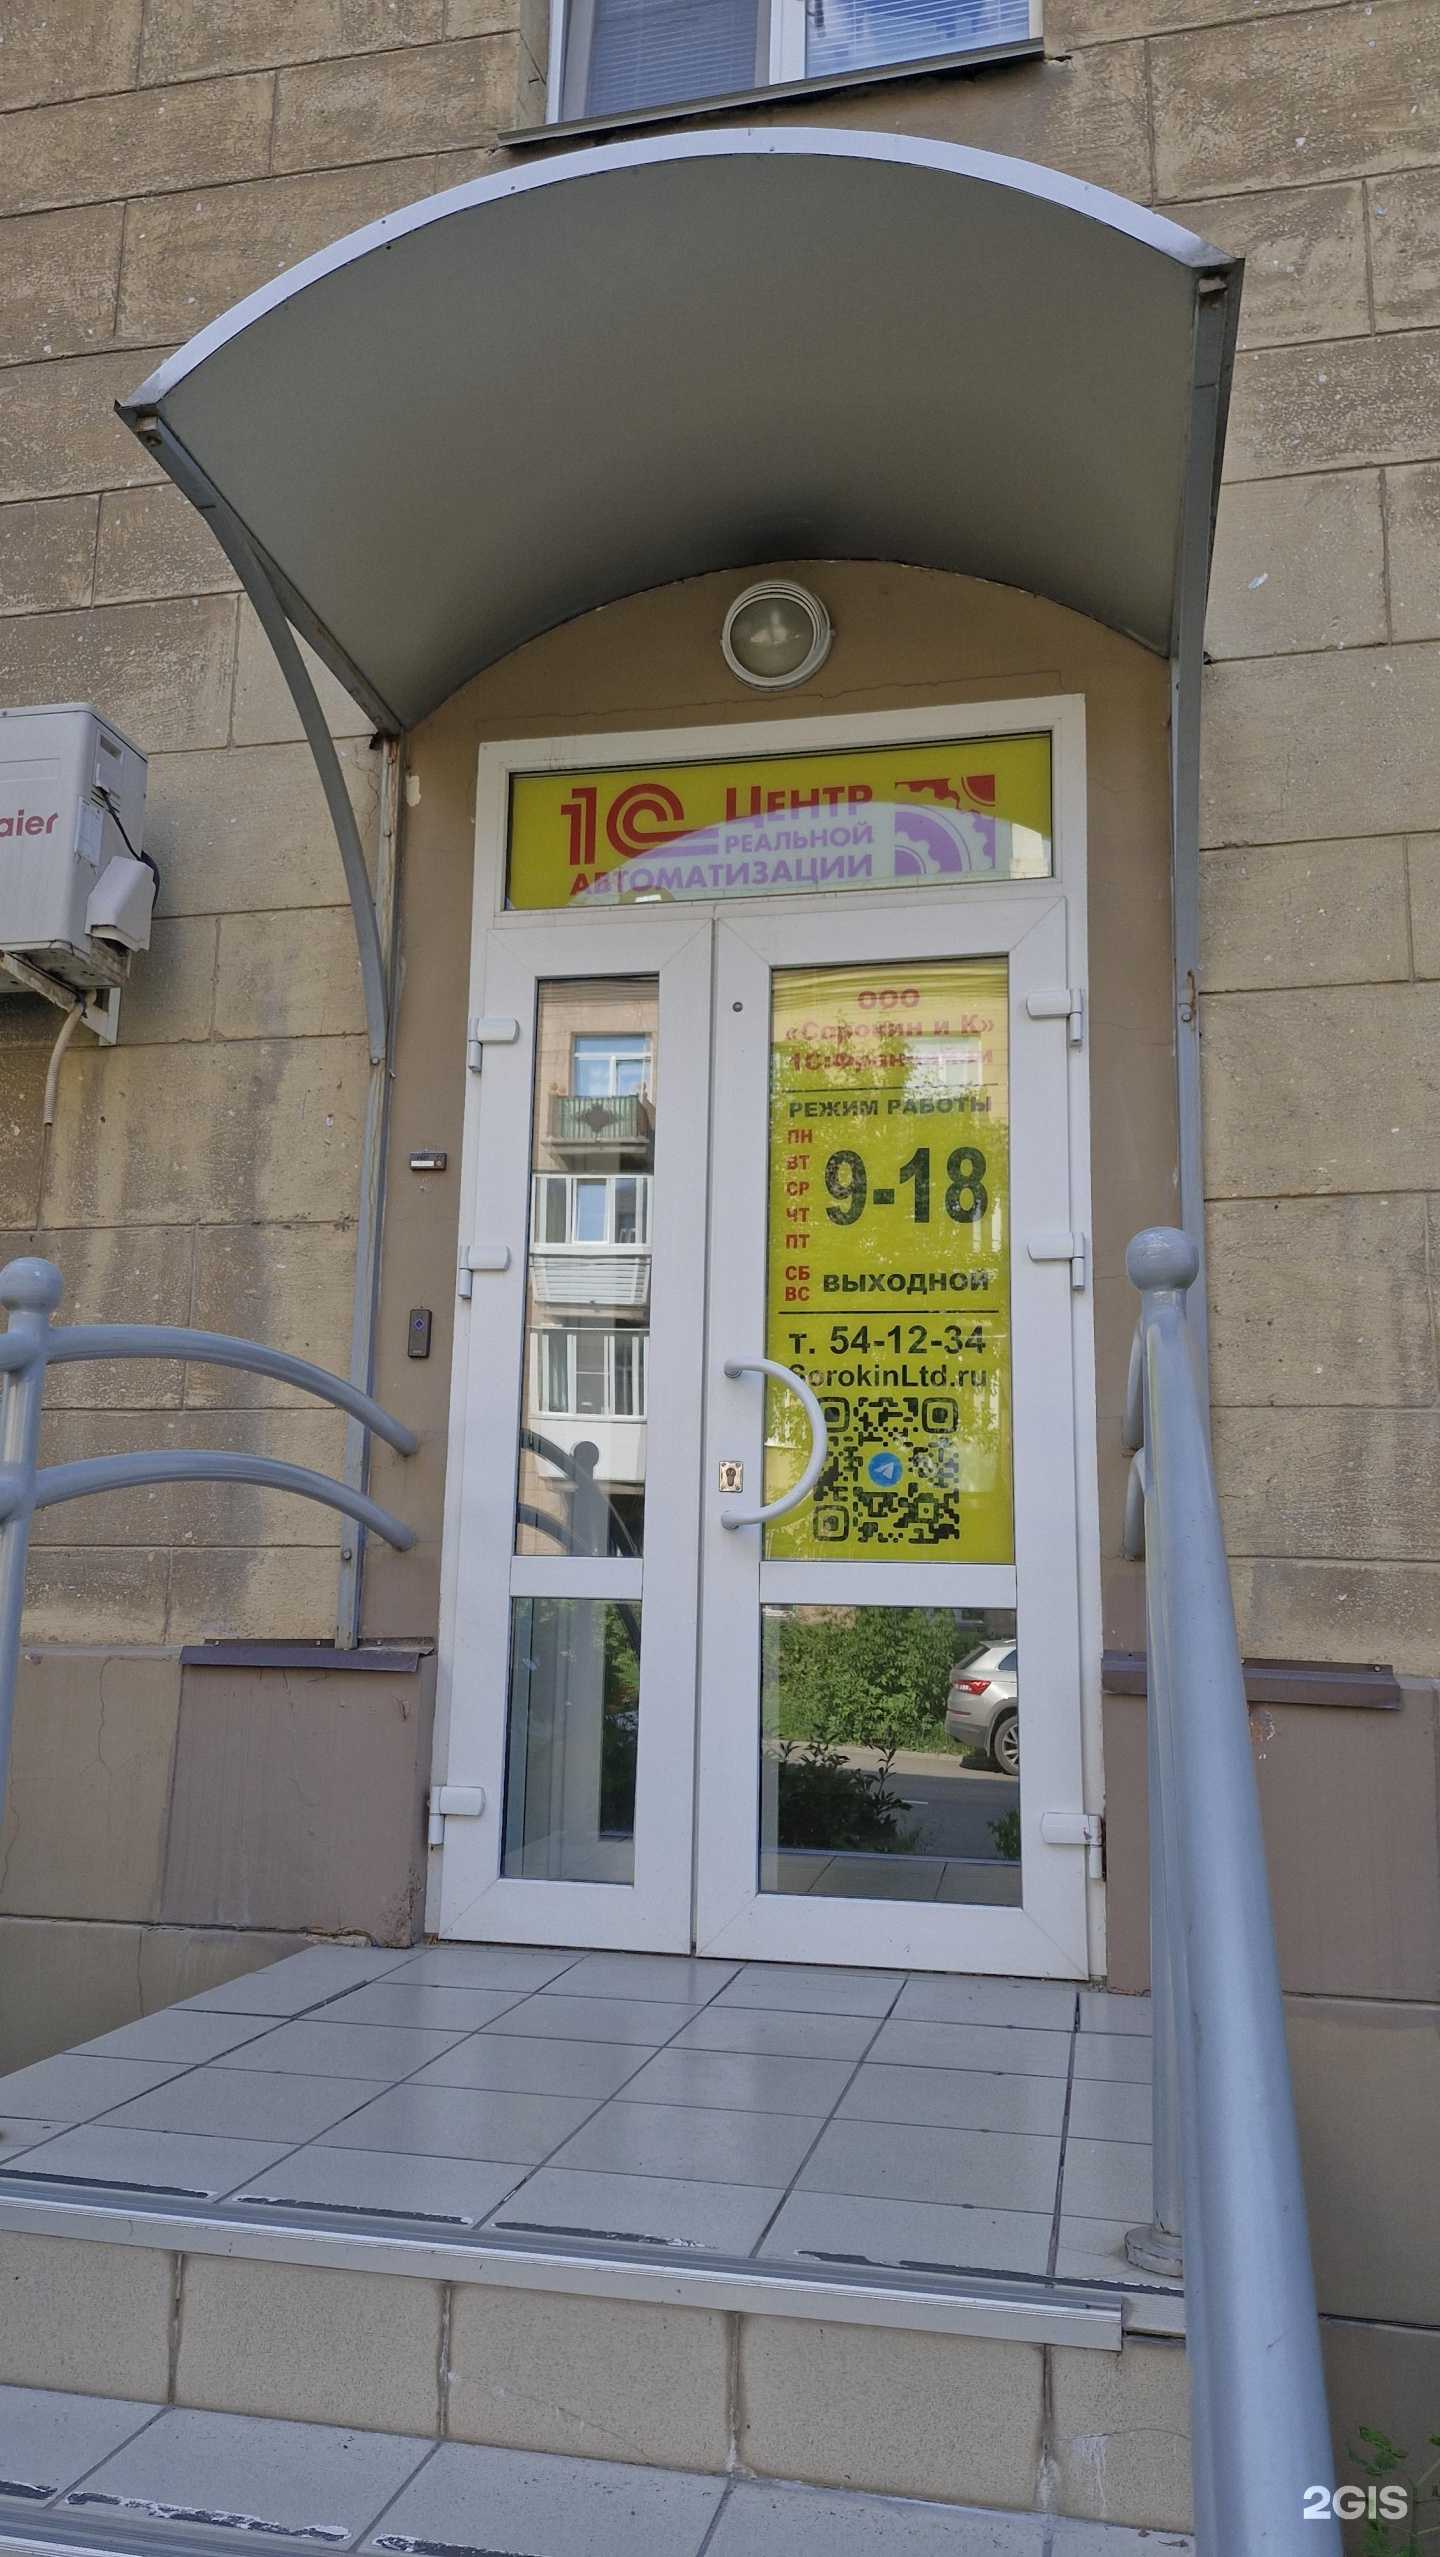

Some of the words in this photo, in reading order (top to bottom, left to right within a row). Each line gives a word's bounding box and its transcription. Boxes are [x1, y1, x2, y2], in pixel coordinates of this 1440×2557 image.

[726, 784, 873, 828] ЦЕНТР
[725, 821, 873, 854] РЕАЛЬНОЙ
[570, 854, 872, 896] АВТОМАТИЗАЦИИ
[857, 988, 920, 1009] ООО
[788, 1099, 879, 1118] РЕЖИМ
[887, 1096, 991, 1115] РАБОТЫ
[787, 1128, 813, 1144] ПН
[785, 1155, 810, 1170] ВТ
[786, 1181, 810, 1197] СР
[825, 1147, 988, 1226] 9-18
[785, 1207, 810, 1222] ЧТ
[785, 1234, 810, 1249] ПТ
[785, 1265, 810, 1281] СБ
[785, 1286, 810, 1302] ВС
[829, 1325, 987, 1354] 54-12-34
